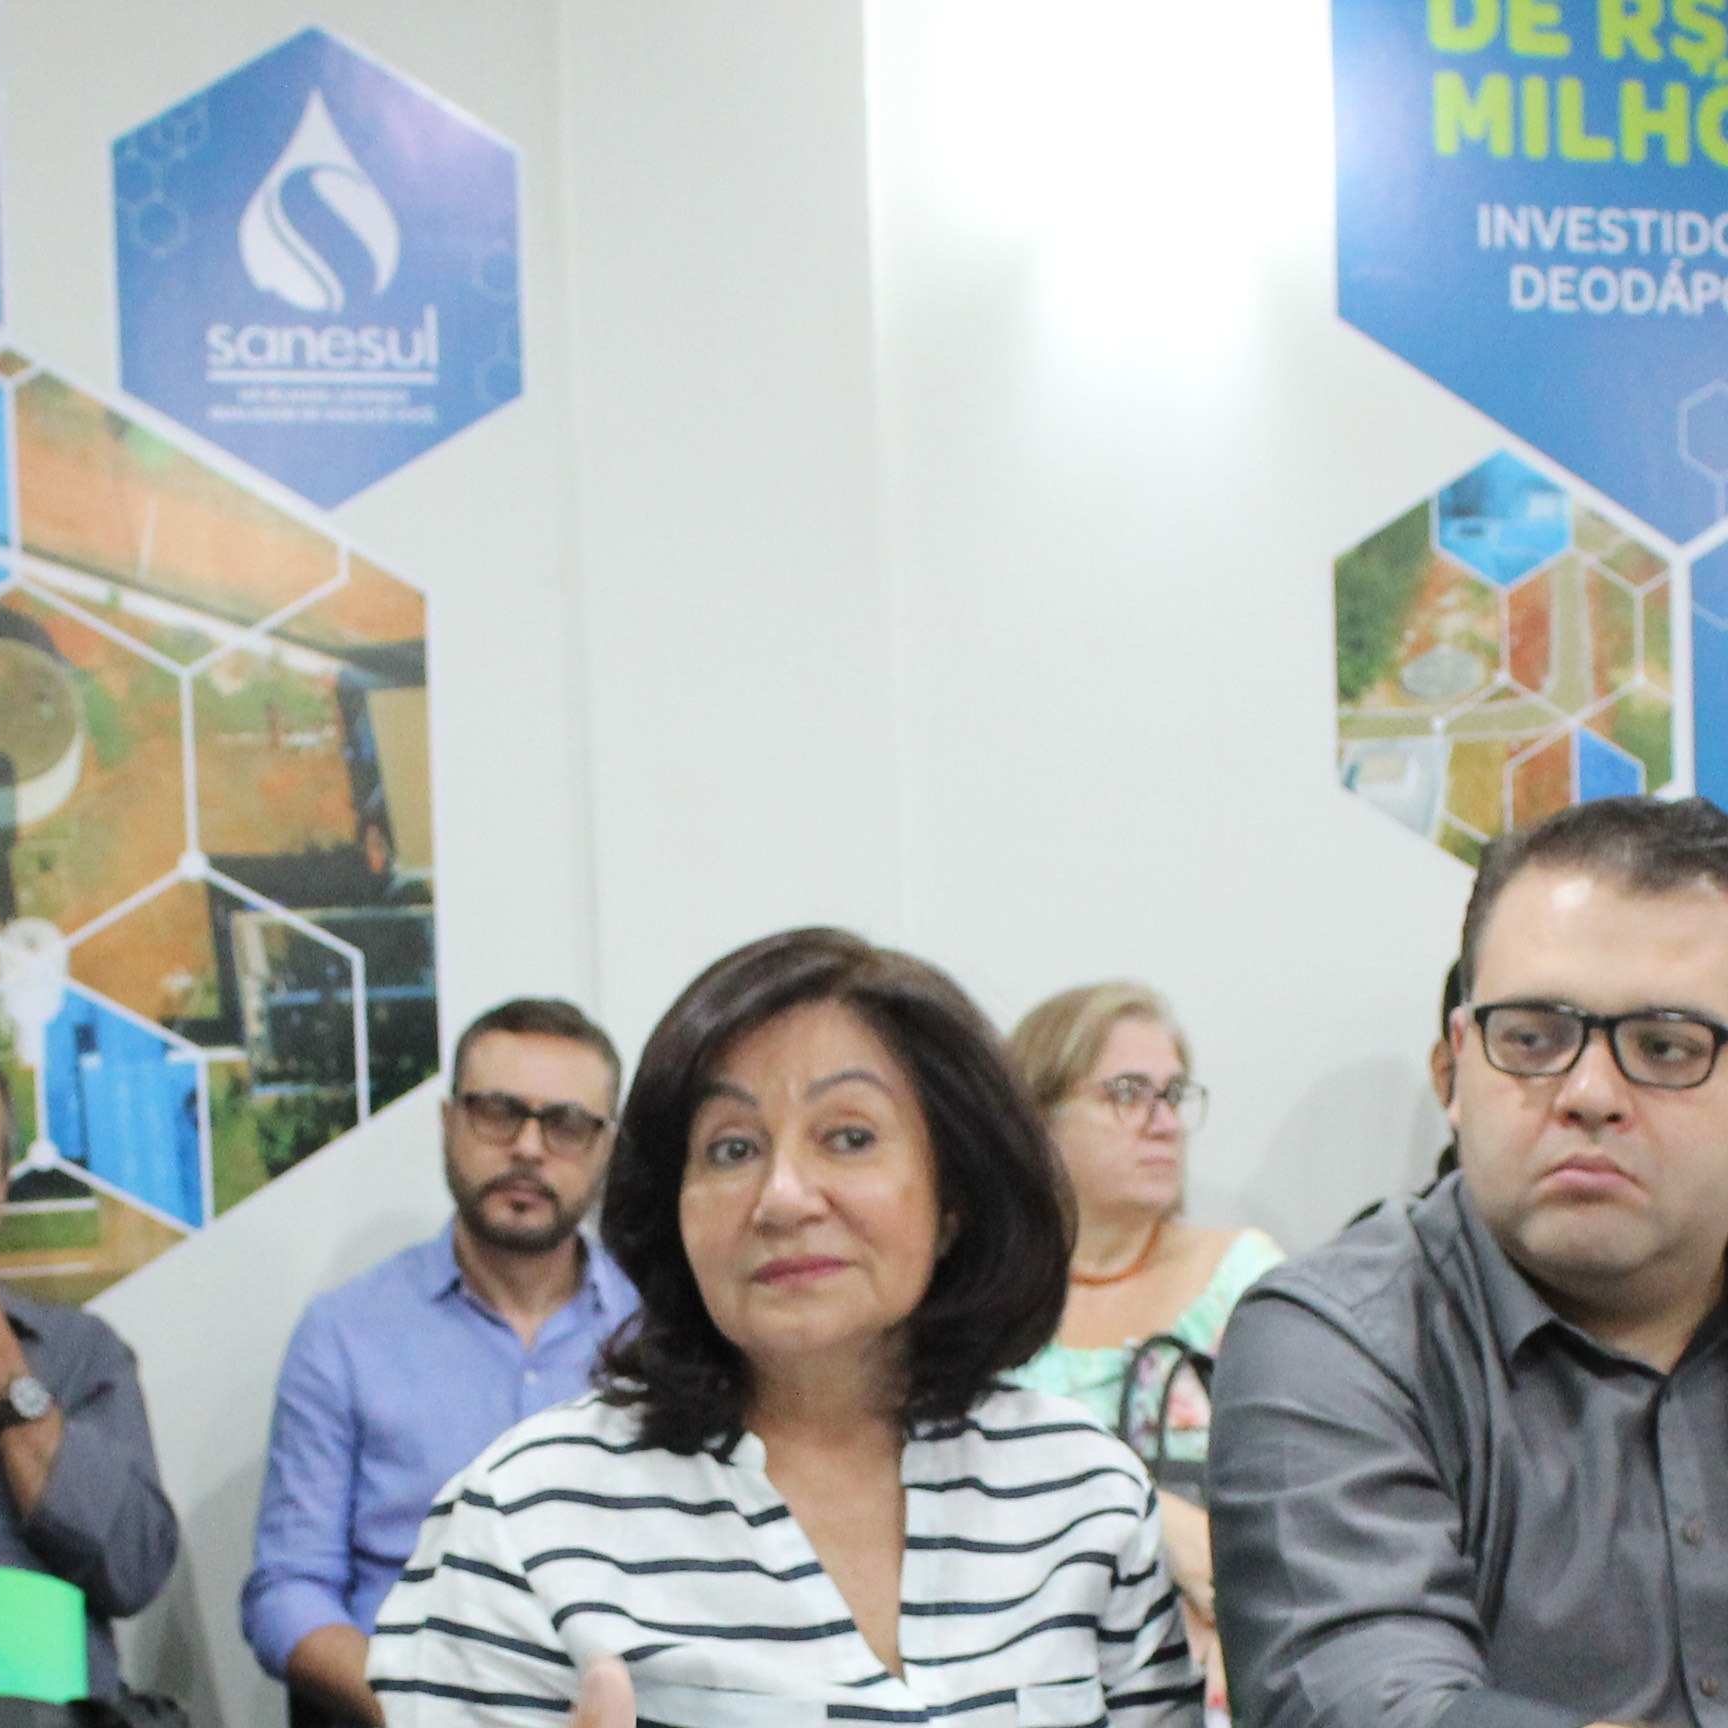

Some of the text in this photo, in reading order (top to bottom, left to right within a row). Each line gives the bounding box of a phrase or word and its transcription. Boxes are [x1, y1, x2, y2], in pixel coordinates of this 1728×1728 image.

[1428, 0, 1570, 57] DE
[1598, 0, 1728, 77] R$
[205, 304, 440, 369] sanesul
